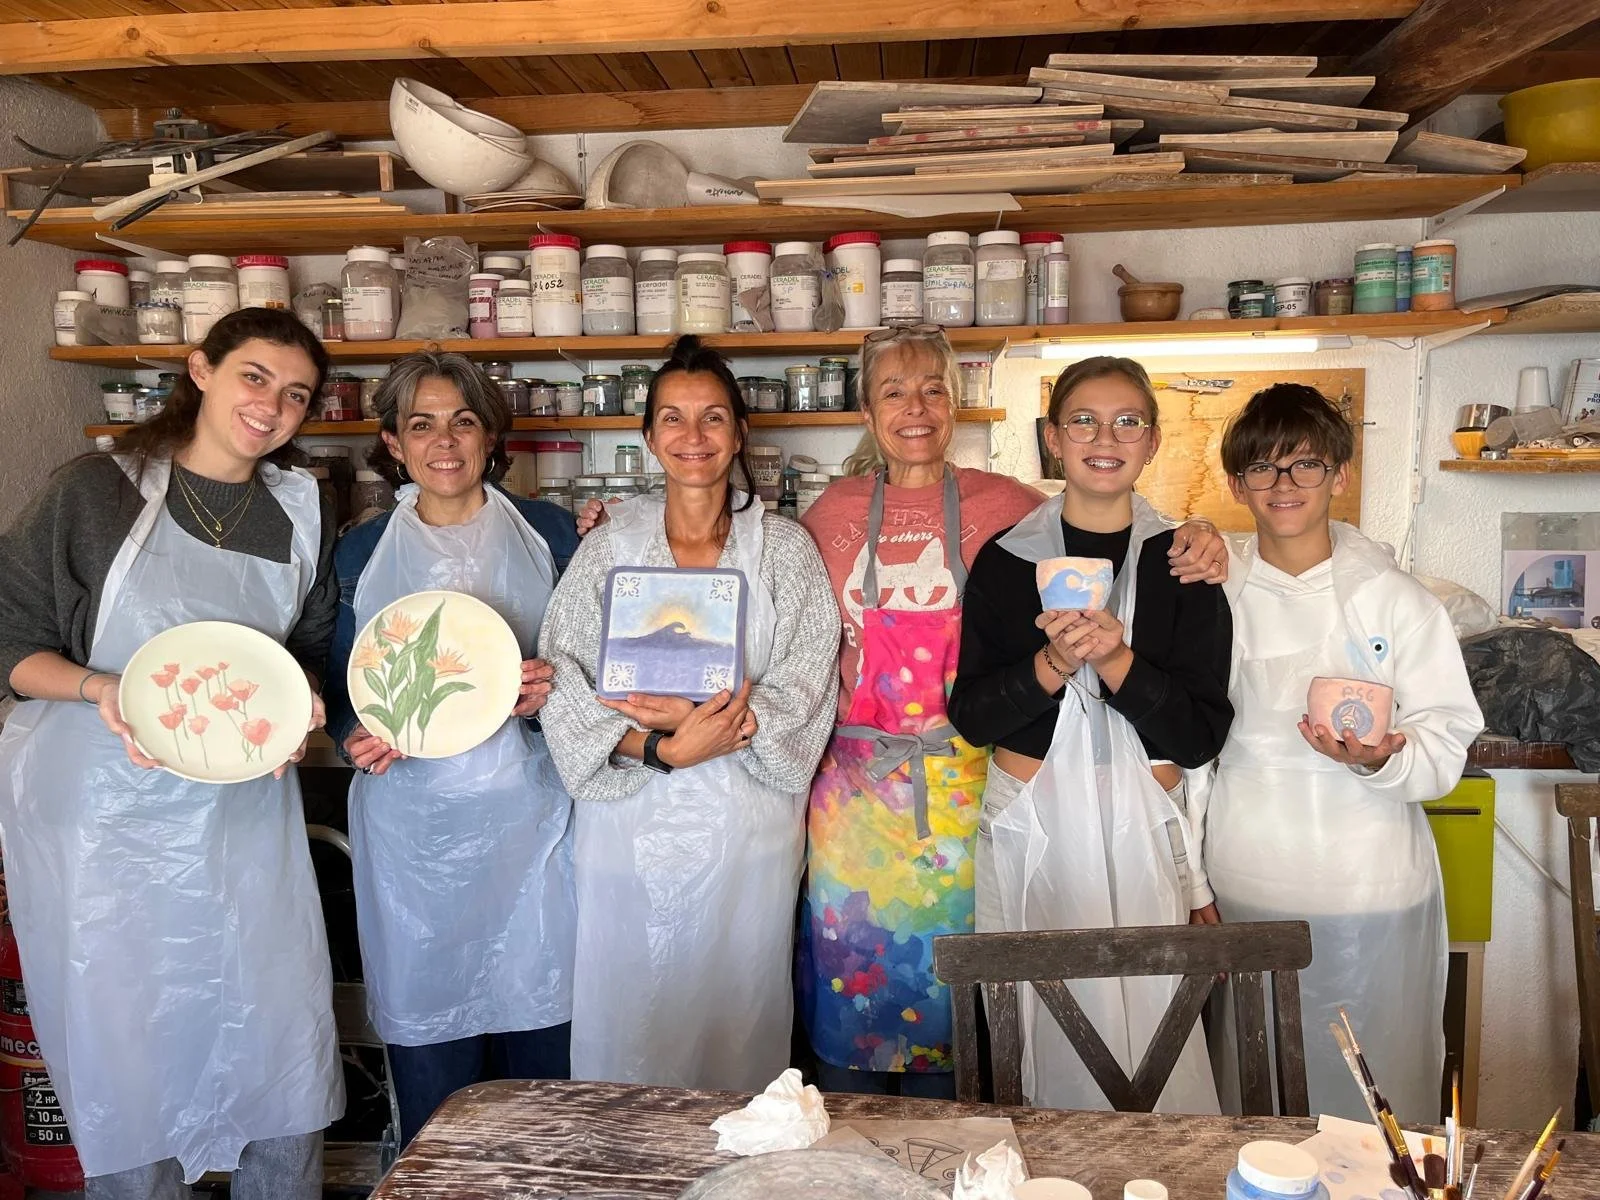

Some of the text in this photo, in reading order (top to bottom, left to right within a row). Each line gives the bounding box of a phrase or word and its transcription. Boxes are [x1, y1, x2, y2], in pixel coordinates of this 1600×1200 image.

[890, 530, 934, 544] others
[35, 1091, 57, 1104] 2 HP
[37, 1111, 50, 1123] 10
[38, 1129, 54, 1141] 50
